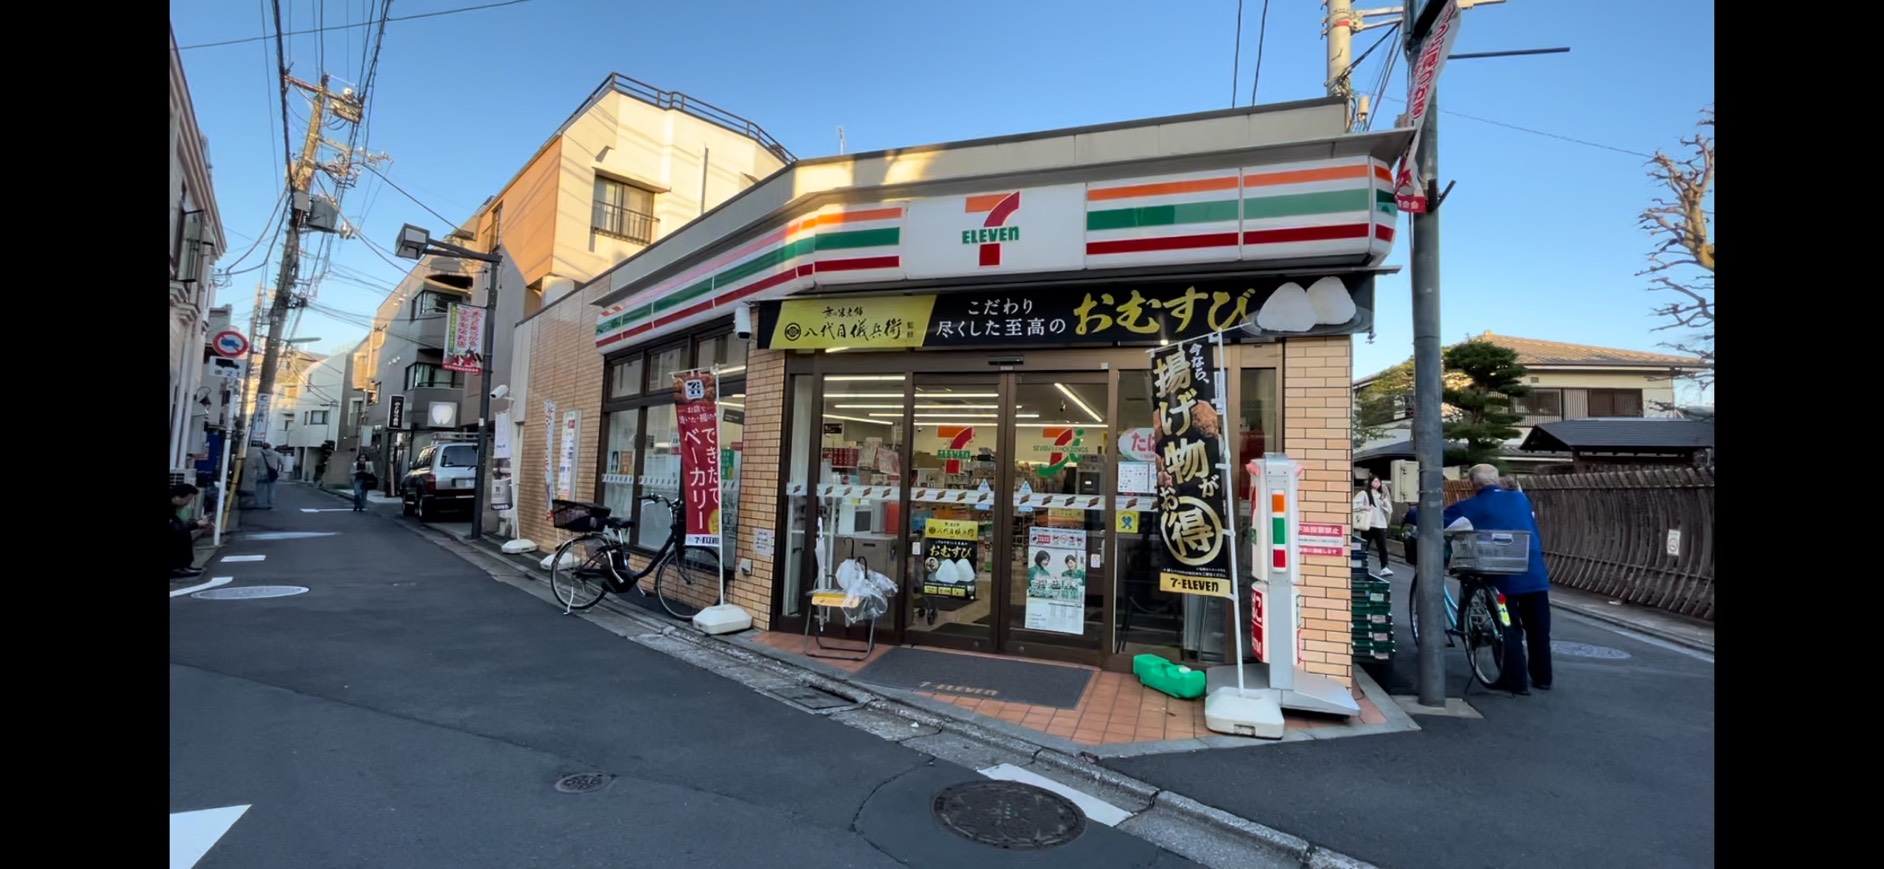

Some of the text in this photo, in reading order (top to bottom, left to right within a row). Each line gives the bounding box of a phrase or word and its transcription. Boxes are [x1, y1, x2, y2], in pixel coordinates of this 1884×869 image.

[936, 318, 1066, 338] 尽くした至高の
[968, 298, 1033, 315] こだわり
[1073, 286, 1256, 335] おむすび
[684, 428, 706, 529] ベーカリー
[702, 427, 720, 503] できたて
